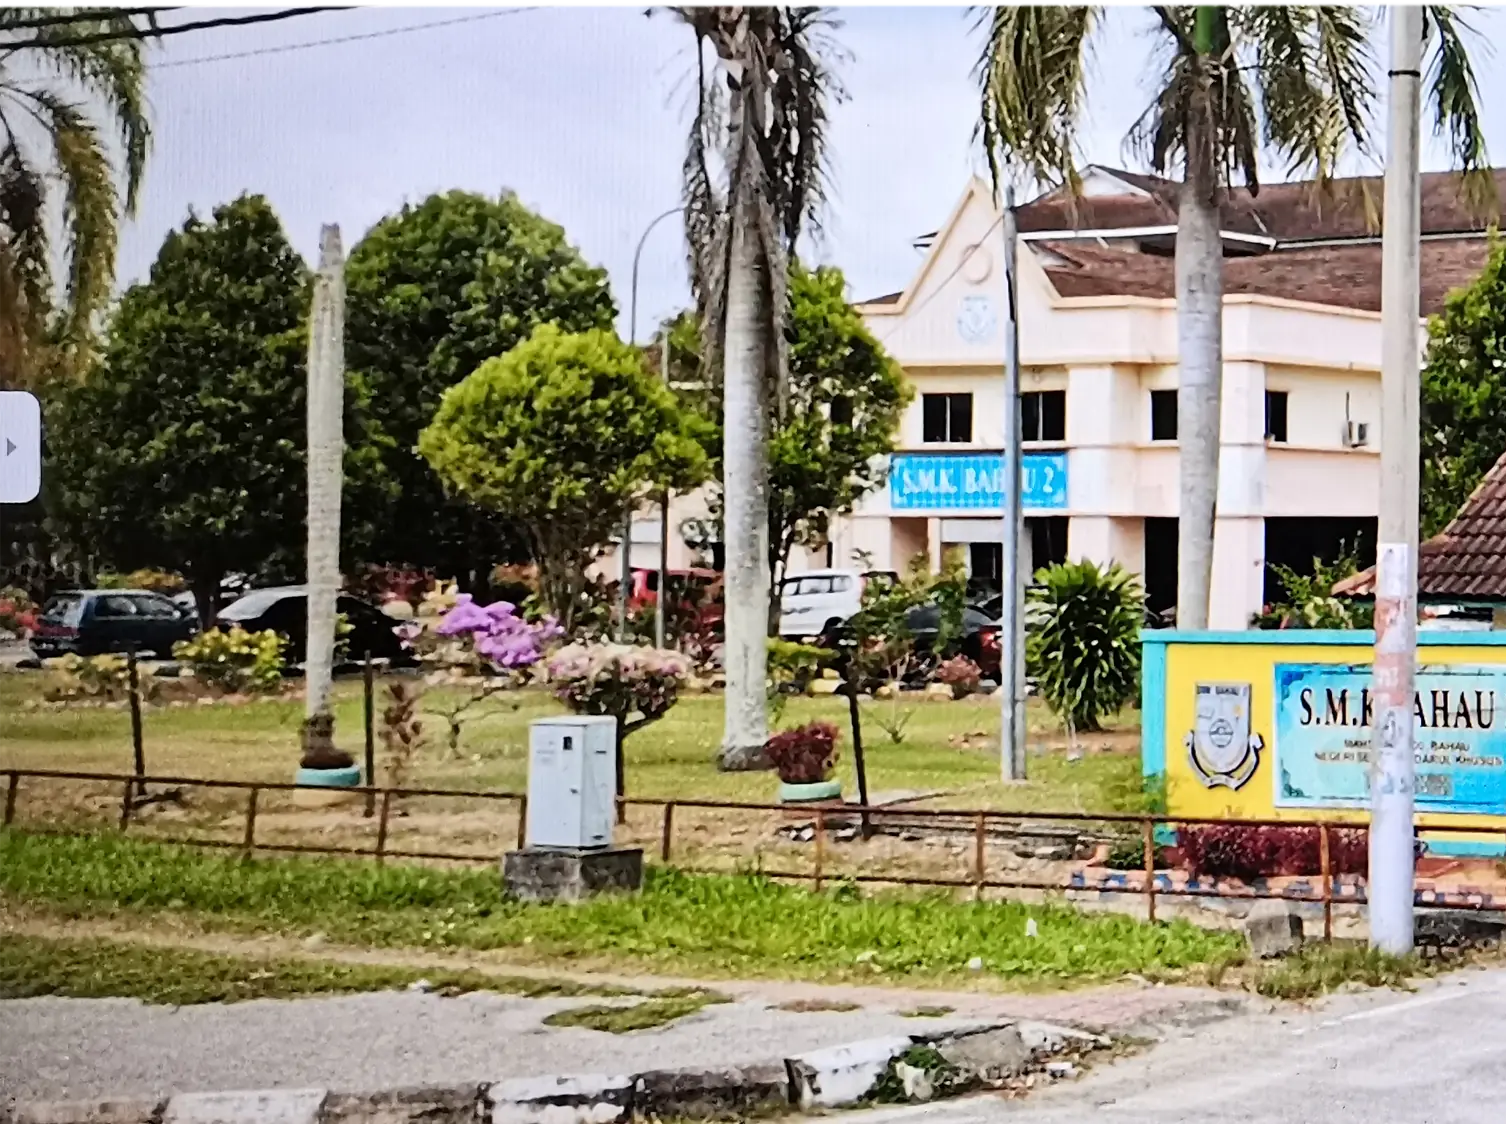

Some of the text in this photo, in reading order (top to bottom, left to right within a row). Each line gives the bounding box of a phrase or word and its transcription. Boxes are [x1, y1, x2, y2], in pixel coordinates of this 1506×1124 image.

[965, 466, 1036, 494] BAHU
[1042, 465, 1055, 494] 2
[1413, 690, 1495, 729] AHAU
